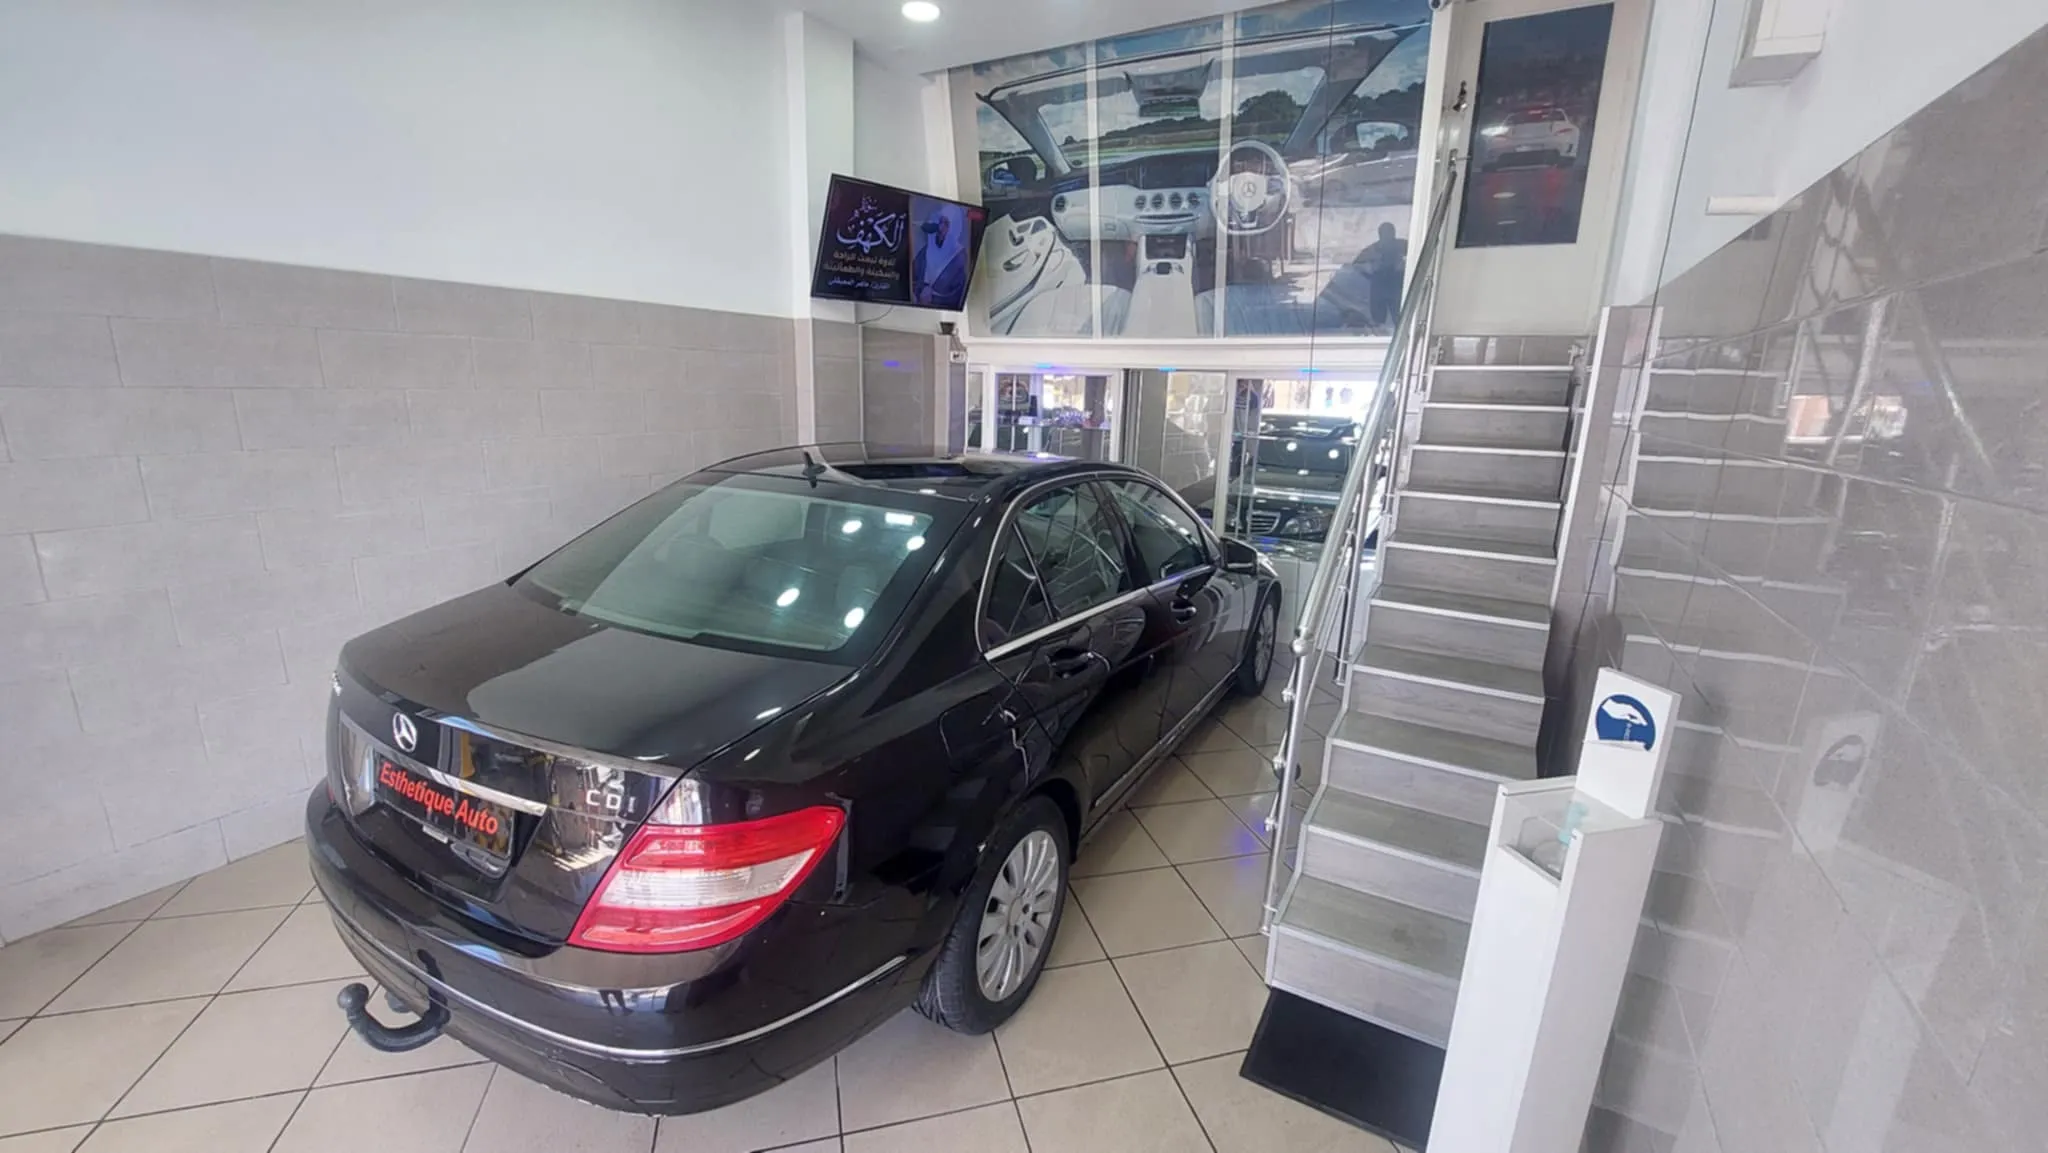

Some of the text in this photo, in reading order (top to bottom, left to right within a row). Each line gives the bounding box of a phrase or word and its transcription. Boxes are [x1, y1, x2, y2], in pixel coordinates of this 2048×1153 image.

[379, 761, 499, 836] Esthetique Auto
[585, 789, 636, 813] CDI
